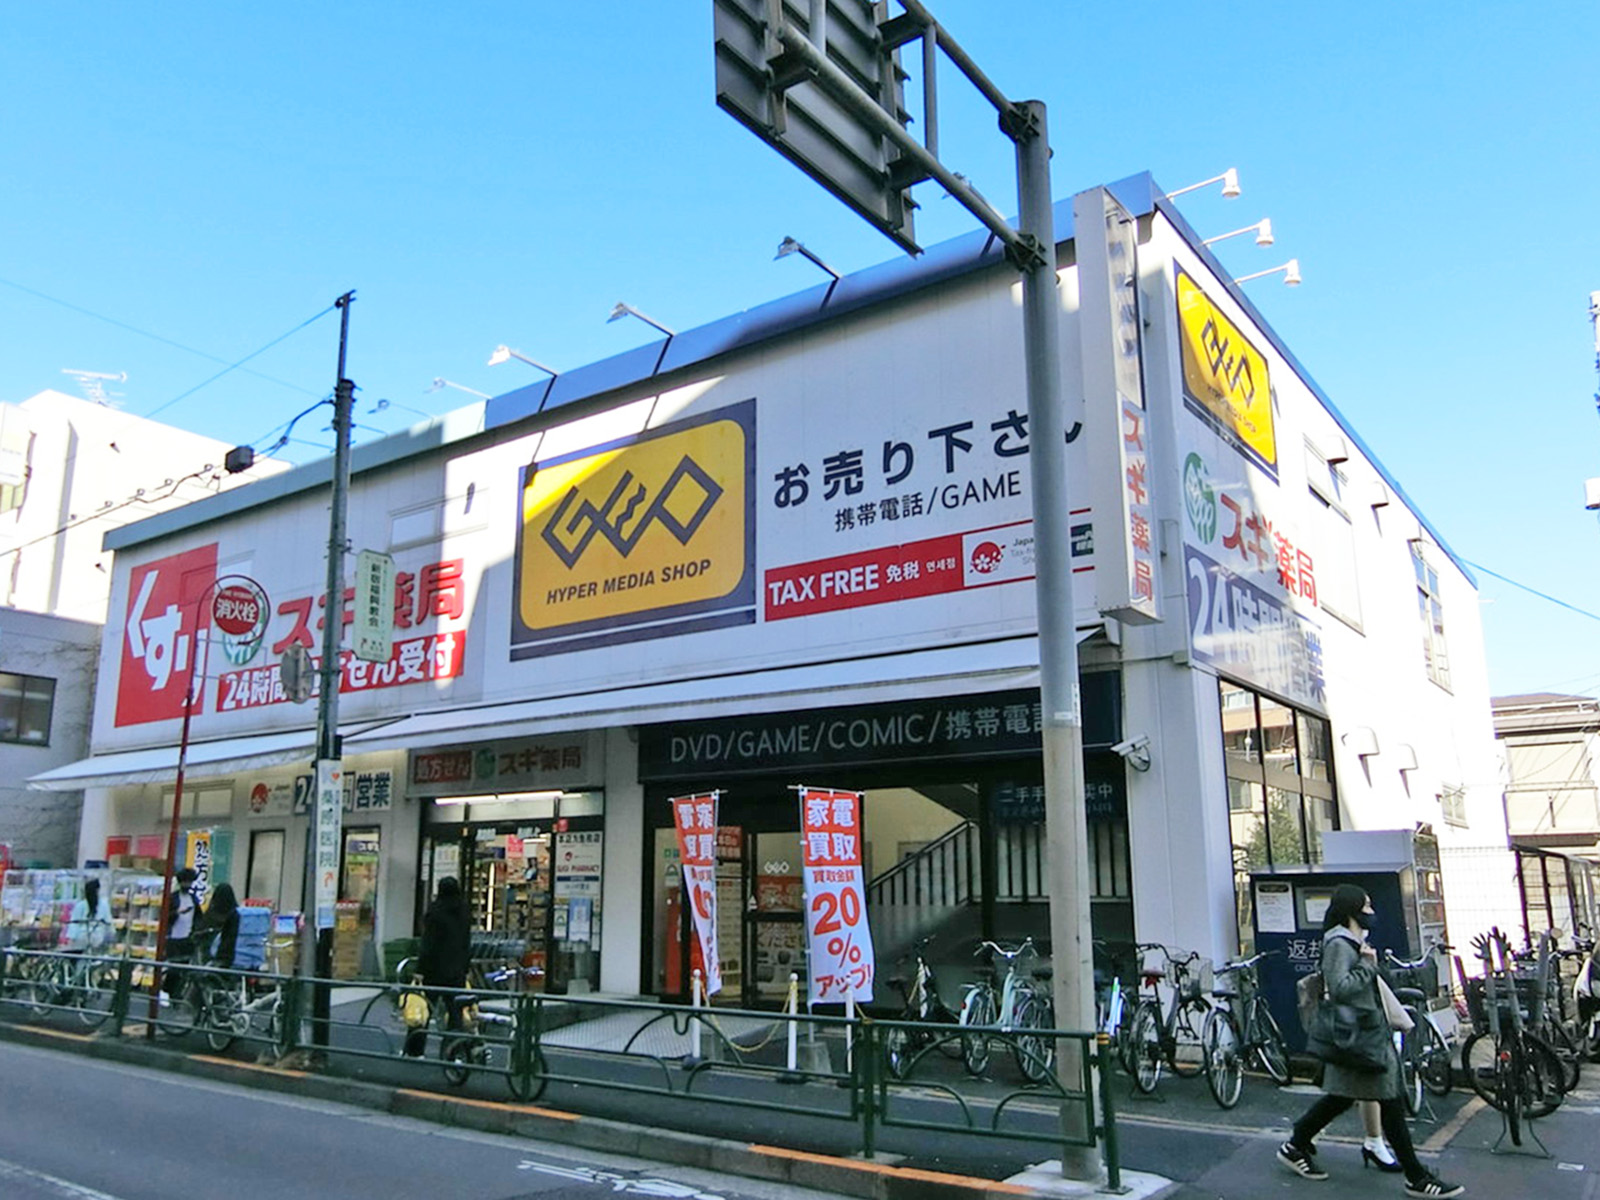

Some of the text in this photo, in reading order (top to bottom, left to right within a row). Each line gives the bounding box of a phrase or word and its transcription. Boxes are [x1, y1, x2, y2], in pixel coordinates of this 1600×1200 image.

[773, 409, 1083, 508] お売り下さ
[541, 454, 724, 570] GEO
[834, 470, 1021, 532] 携帯電話/GAME
[1123, 408, 1153, 601] スギ薬局
[1220, 493, 1317, 608] スギ薬局
[546, 559, 712, 605] HYPER MEDIA SHOP
[768, 575, 815, 606] TAX
[819, 564, 879, 599] FREE
[886, 560, 920, 584] 免税
[216, 598, 257, 623] 消火栓
[127, 570, 208, 707] くすり
[222, 634, 456, 711] 24時間せん受付
[500, 745, 582, 776] スギ薬局
[807, 797, 855, 827] 家電
[808, 832, 856, 861] 買取
[812, 887, 860, 936] 20
[827, 933, 861, 969] %
